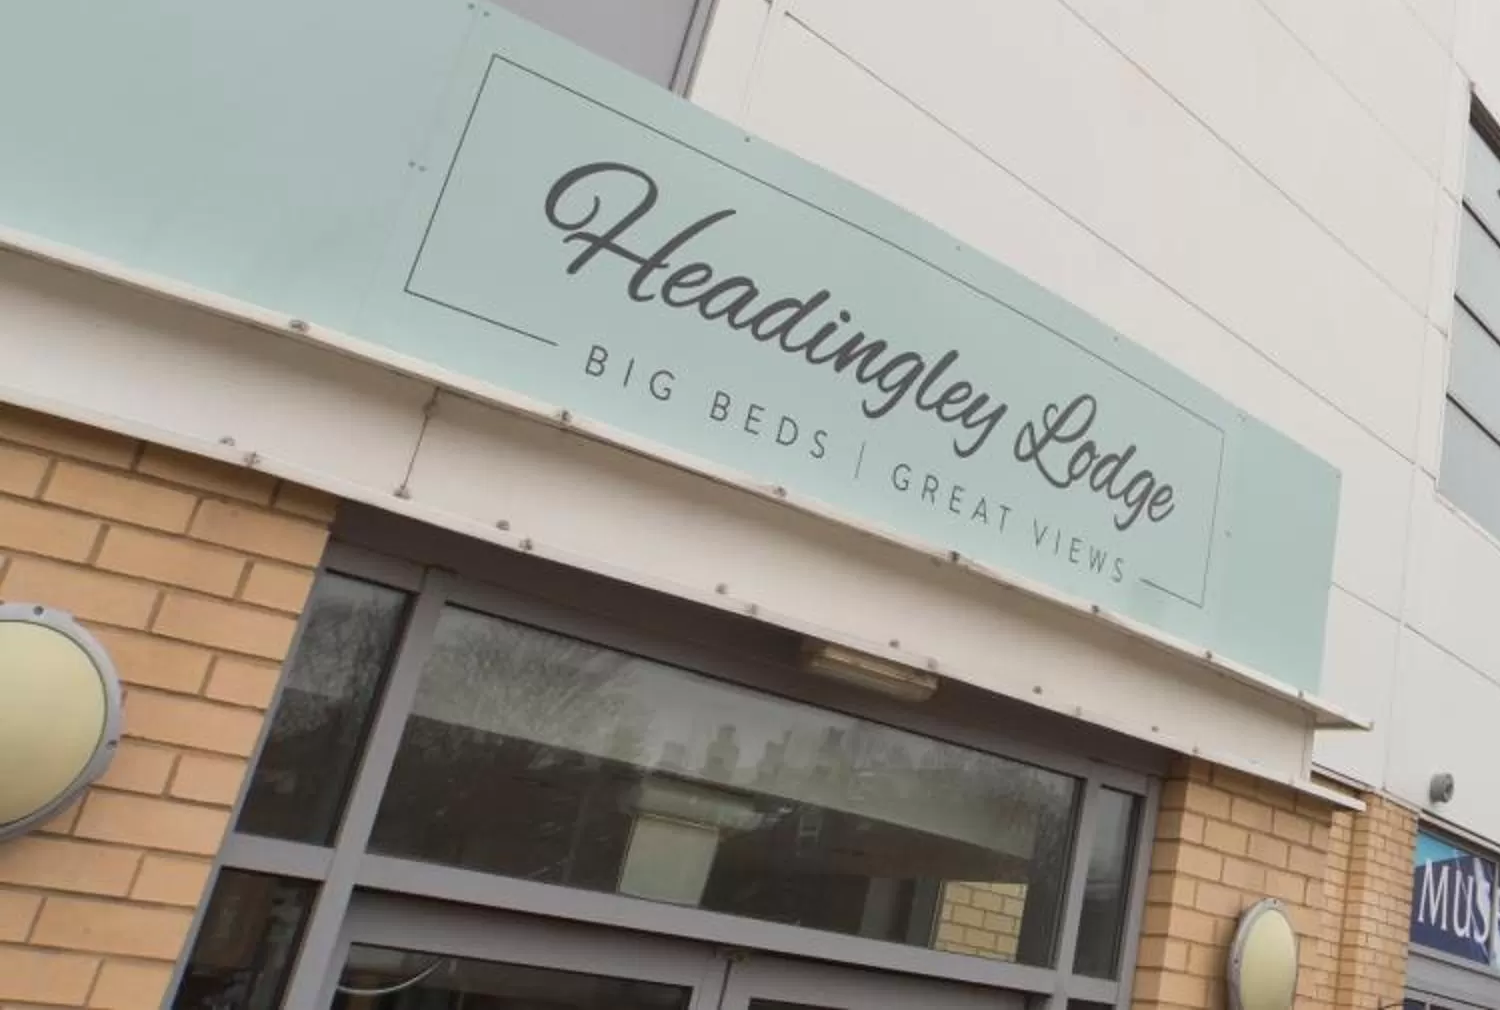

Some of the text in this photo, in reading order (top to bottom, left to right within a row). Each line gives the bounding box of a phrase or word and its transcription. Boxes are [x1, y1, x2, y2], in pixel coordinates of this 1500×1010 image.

[544, 161, 1174, 530] Headingley Lodge
[585, 345, 1126, 583] BIG BEDS GREAT VIEWS
